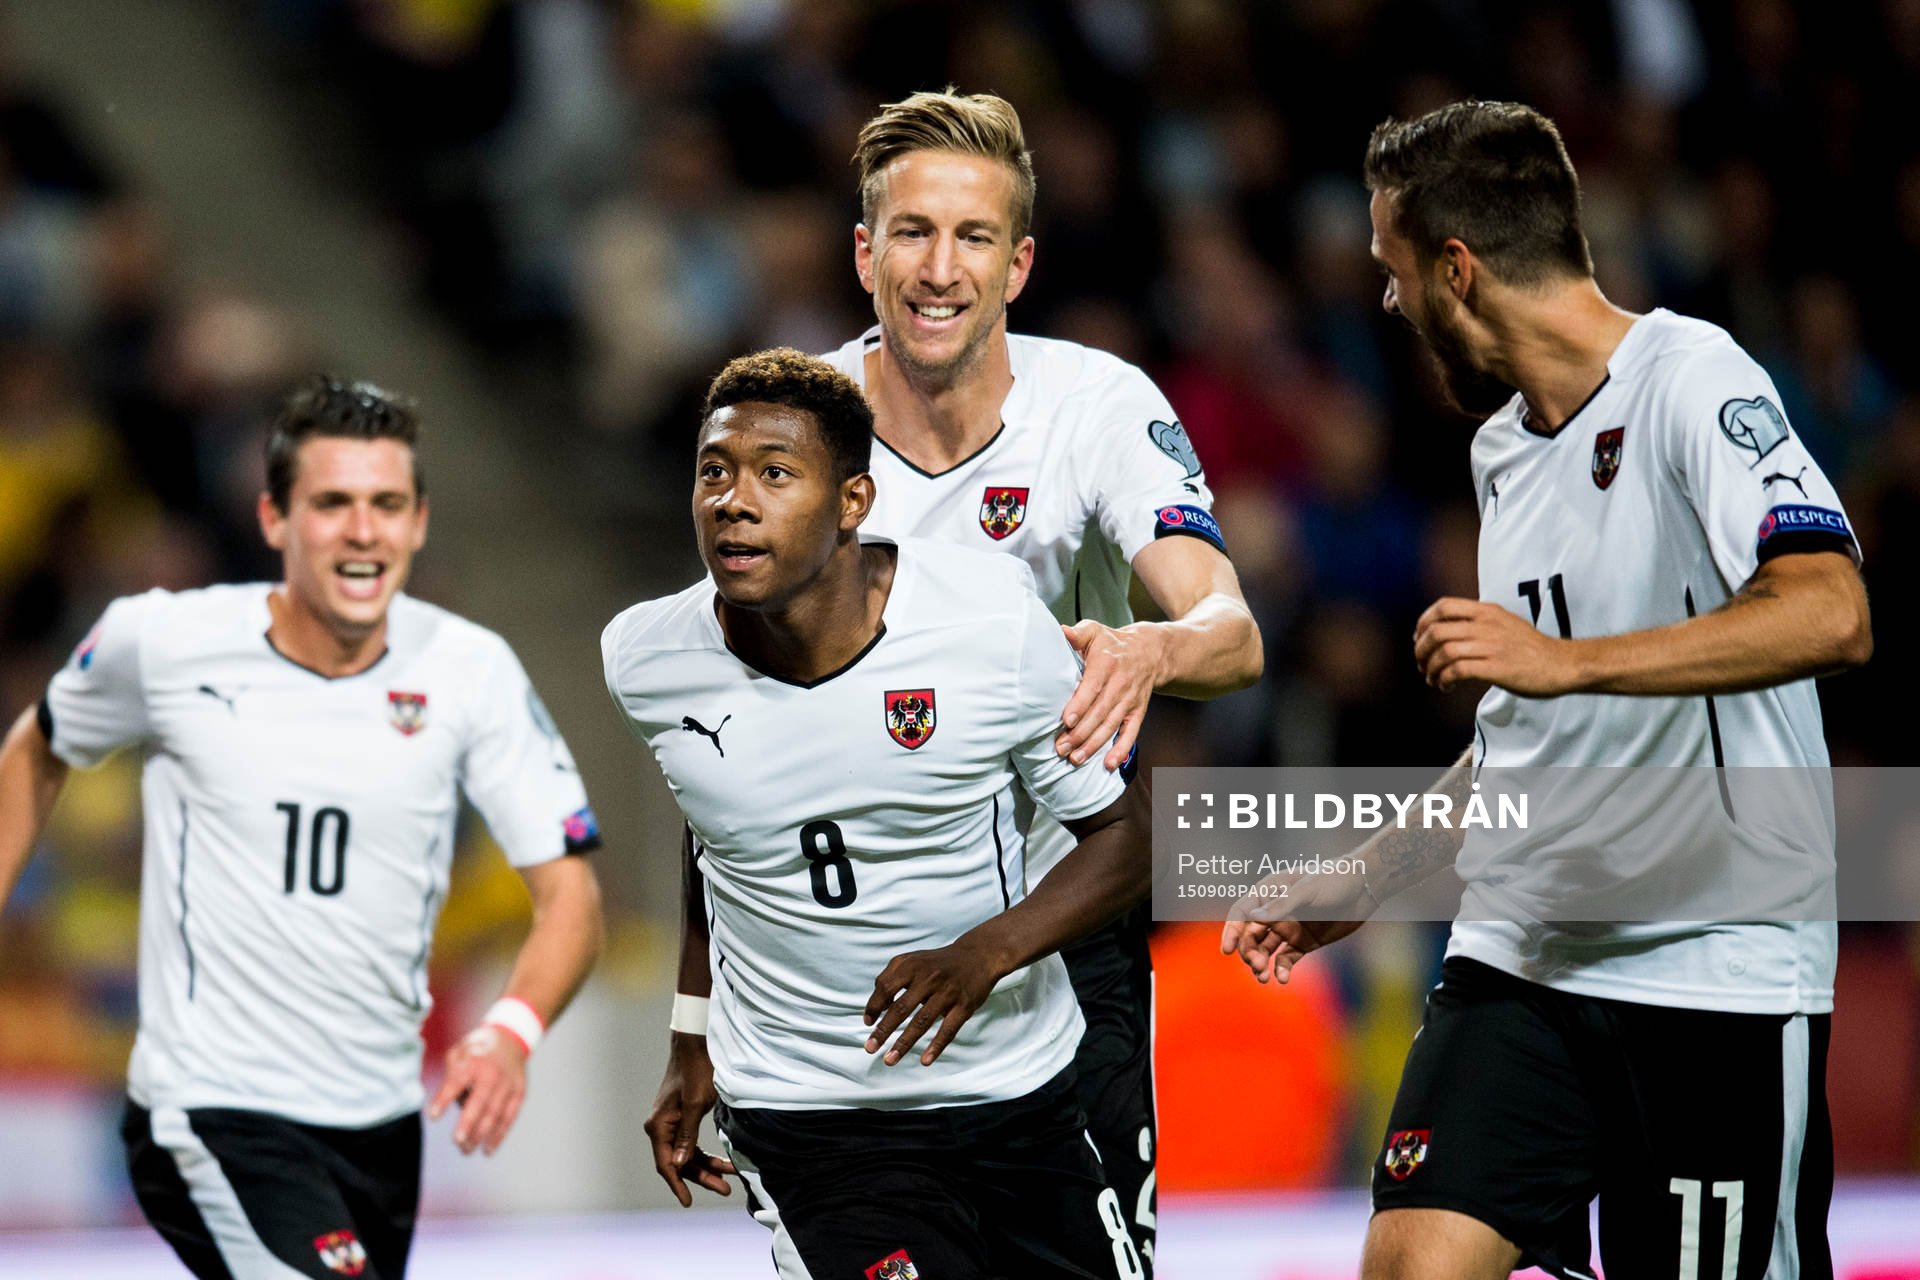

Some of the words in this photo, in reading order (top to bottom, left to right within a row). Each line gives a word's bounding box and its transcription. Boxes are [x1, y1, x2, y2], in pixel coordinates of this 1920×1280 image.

[1184, 511, 1221, 537] RESPEC
[1777, 510, 1844, 529] RESPECT
[1518, 573, 1572, 640] 11
[276, 801, 350, 896] 10
[799, 820, 858, 909] 8
[1097, 1187, 1145, 1280] 8
[1669, 1177, 1745, 1280] 11
